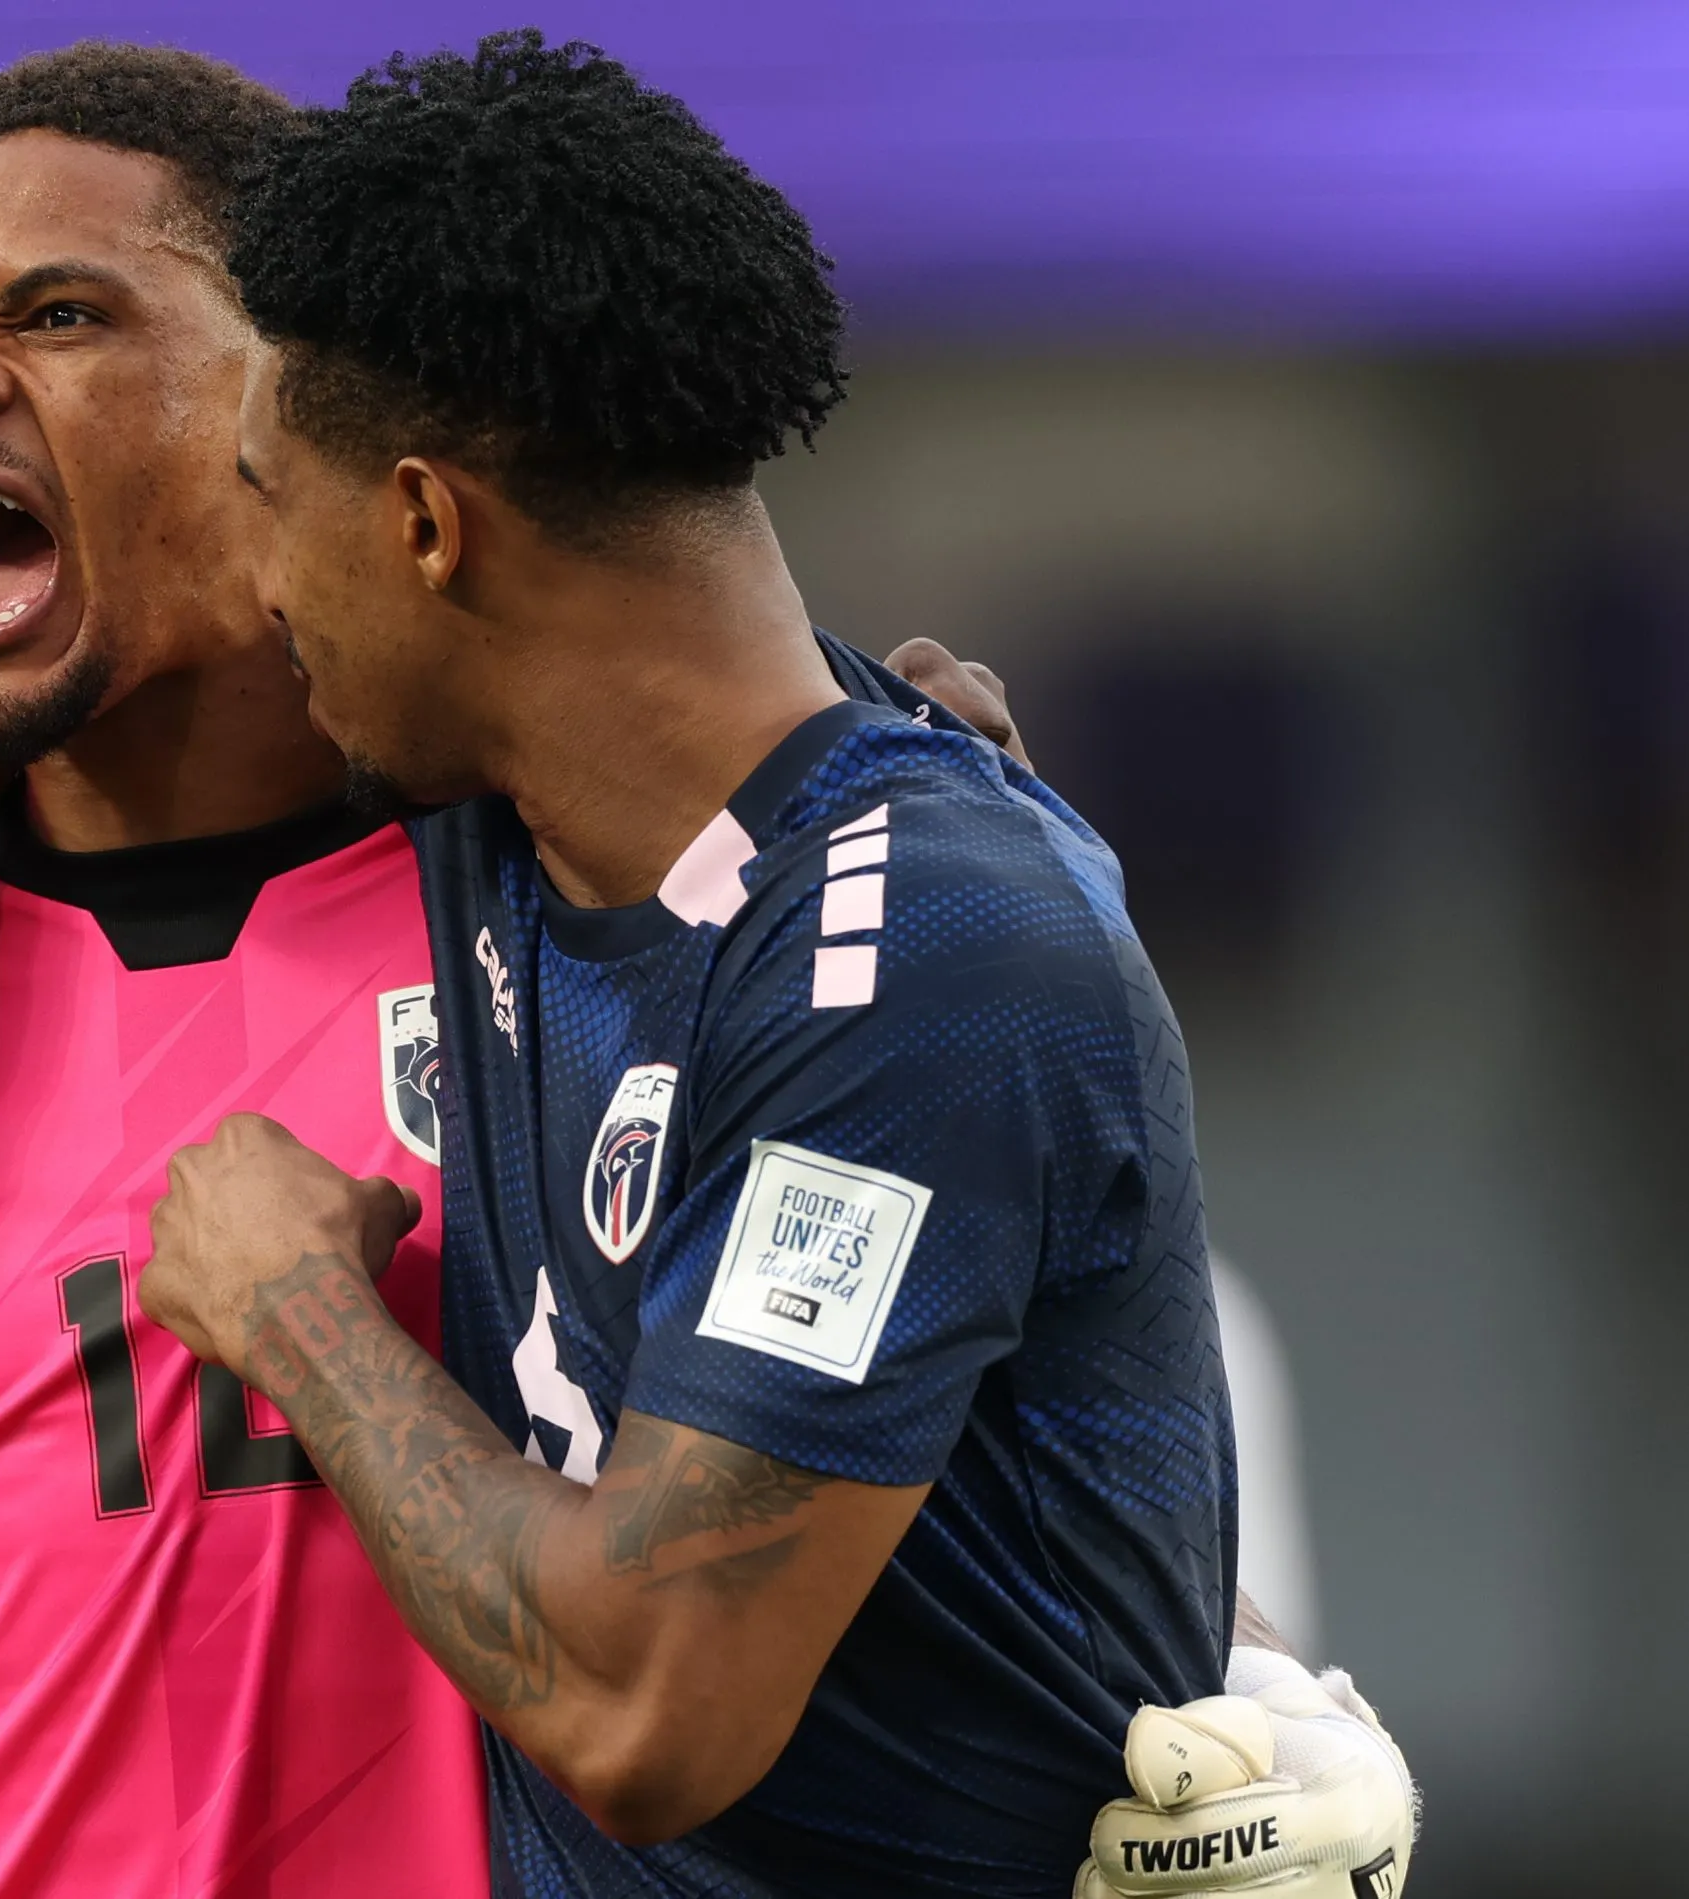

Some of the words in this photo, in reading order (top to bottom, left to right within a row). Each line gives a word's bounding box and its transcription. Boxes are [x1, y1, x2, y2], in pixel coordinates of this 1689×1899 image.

[780, 1185, 876, 1234] FOOTBALL
[772, 1212, 869, 1269] UNITES
[758, 1250, 788, 1278] the
[789, 1258, 863, 1305] World
[768, 1293, 811, 1322] FIFA
[1120, 1816, 1279, 1873] TWOFIVE
